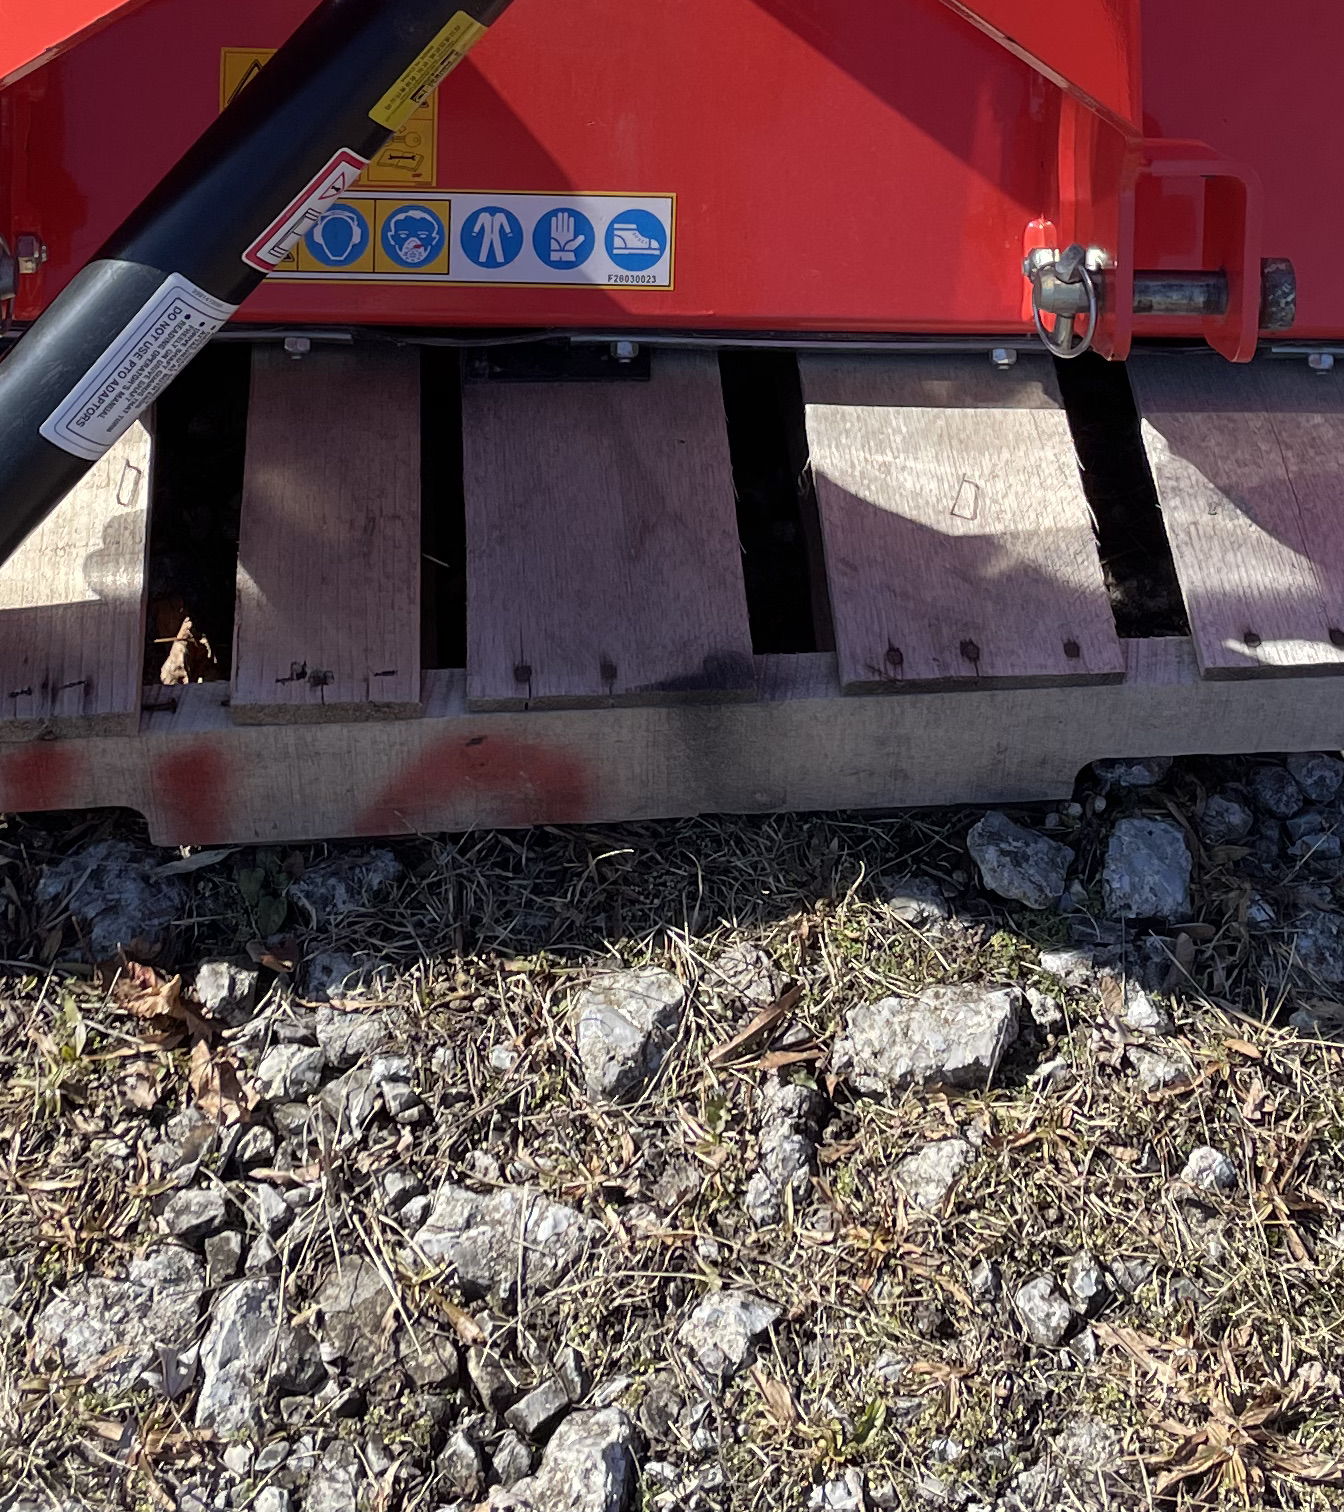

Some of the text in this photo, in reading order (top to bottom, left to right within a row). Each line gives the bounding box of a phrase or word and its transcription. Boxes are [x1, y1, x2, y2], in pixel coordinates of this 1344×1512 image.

[157, 319, 185, 350] READING
[75, 305, 182, 427] DO NOT USE PTO ADAPTORS
[97, 390, 123, 420] MANUAL
